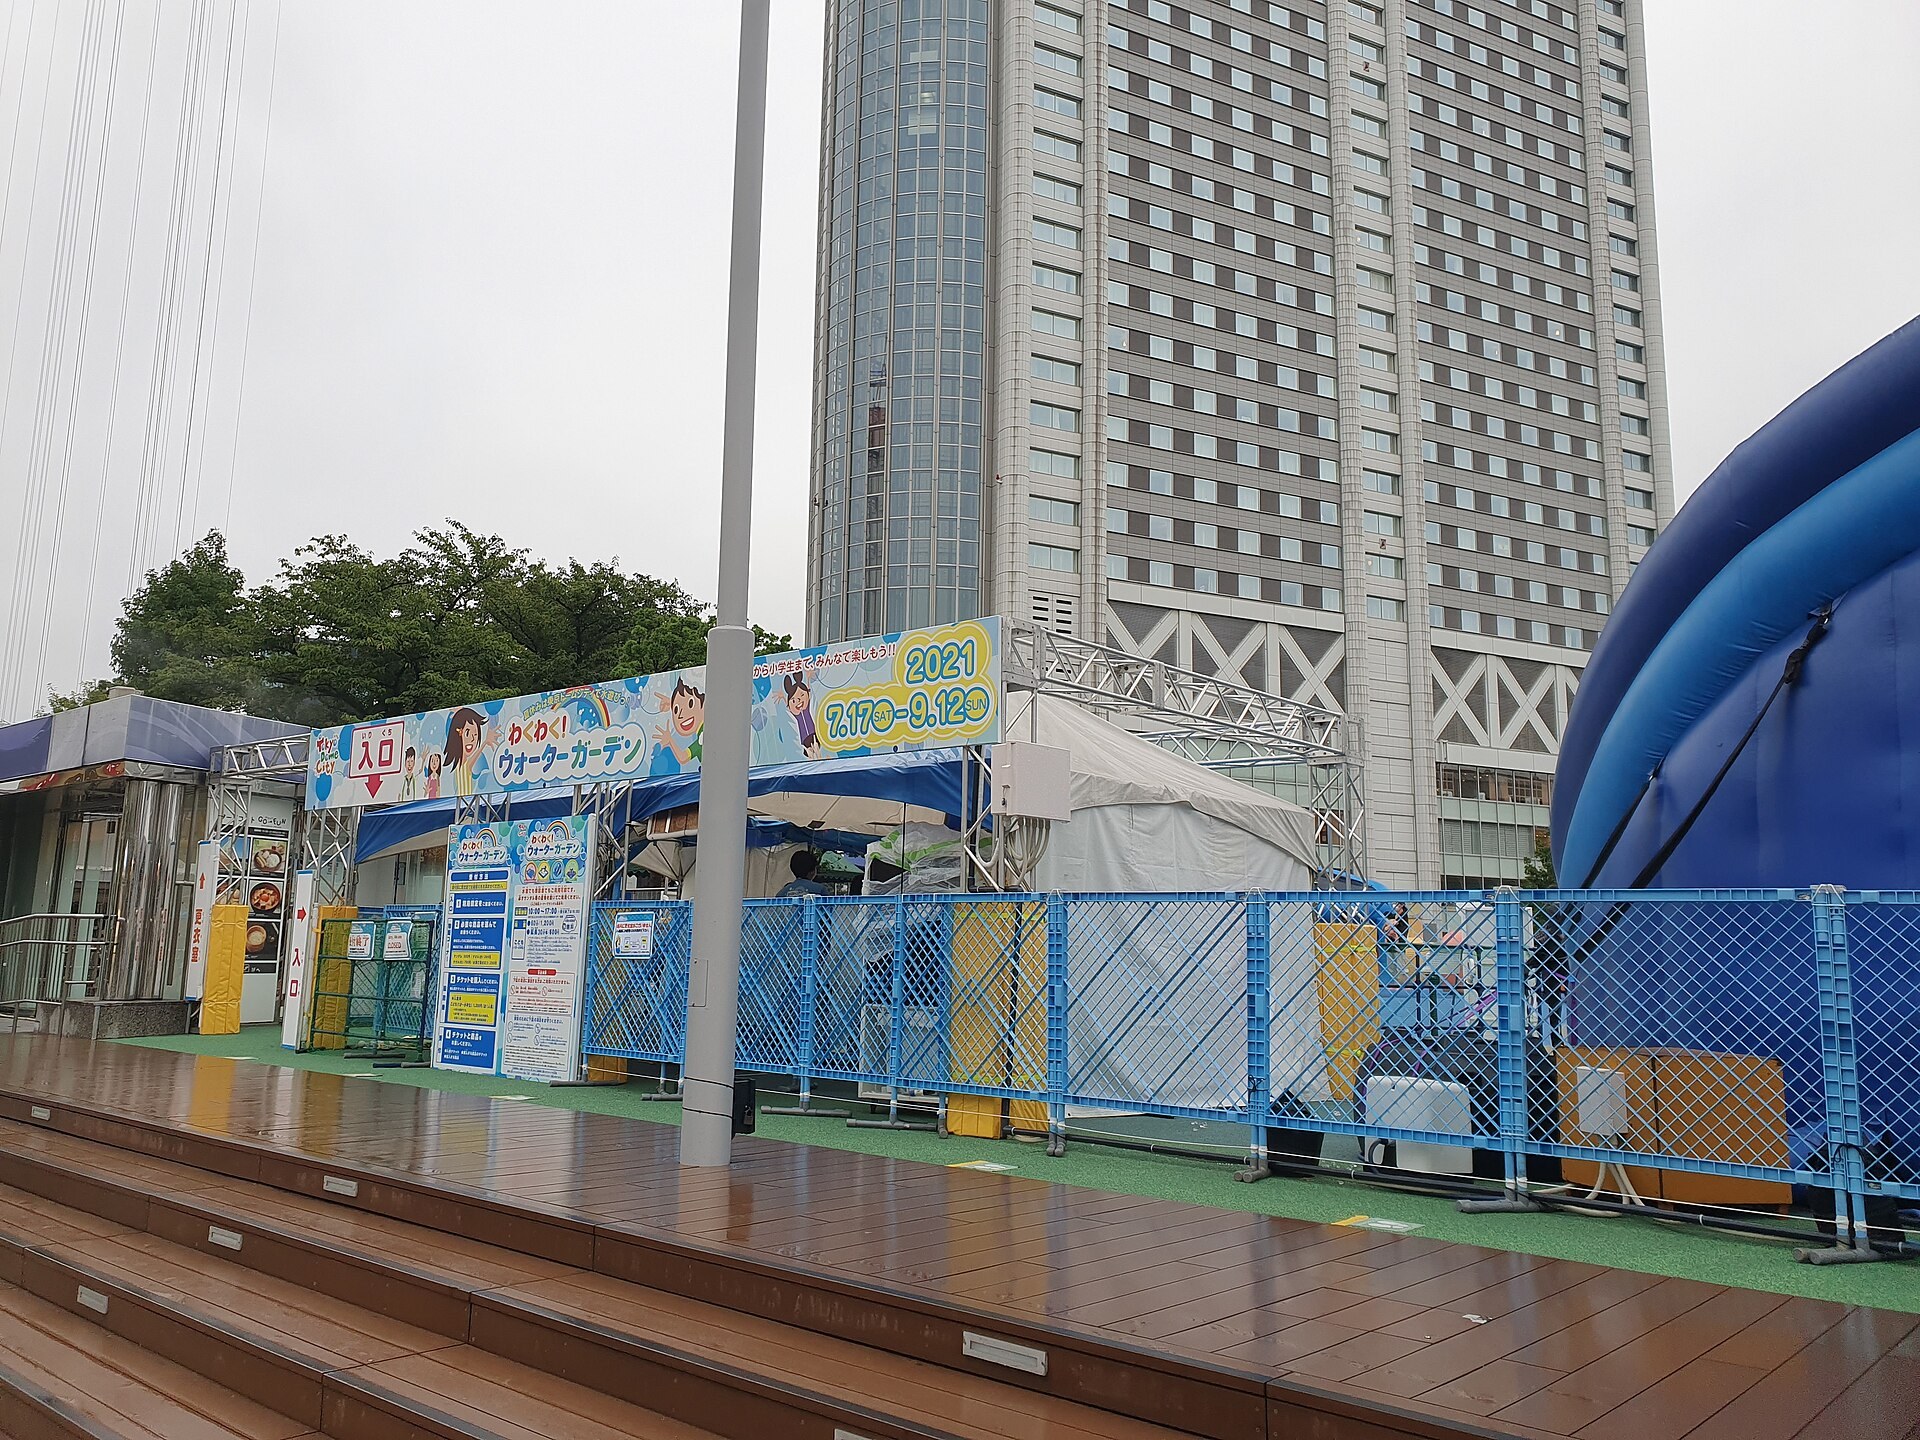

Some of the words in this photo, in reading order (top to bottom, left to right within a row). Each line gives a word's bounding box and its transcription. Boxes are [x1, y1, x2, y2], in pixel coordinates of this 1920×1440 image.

[906, 639, 975, 684] 2021
[508, 715, 567, 746] わくわく!
[358, 739, 393, 770] 入口
[499, 736, 642, 778] ウォーターガーデン
[459, 850, 506, 862] ウォーターガーデン
[527, 844, 580, 857] ウォーターガーデン
[191, 909, 203, 962] 更衣室
[291, 948, 301, 997] 入口
